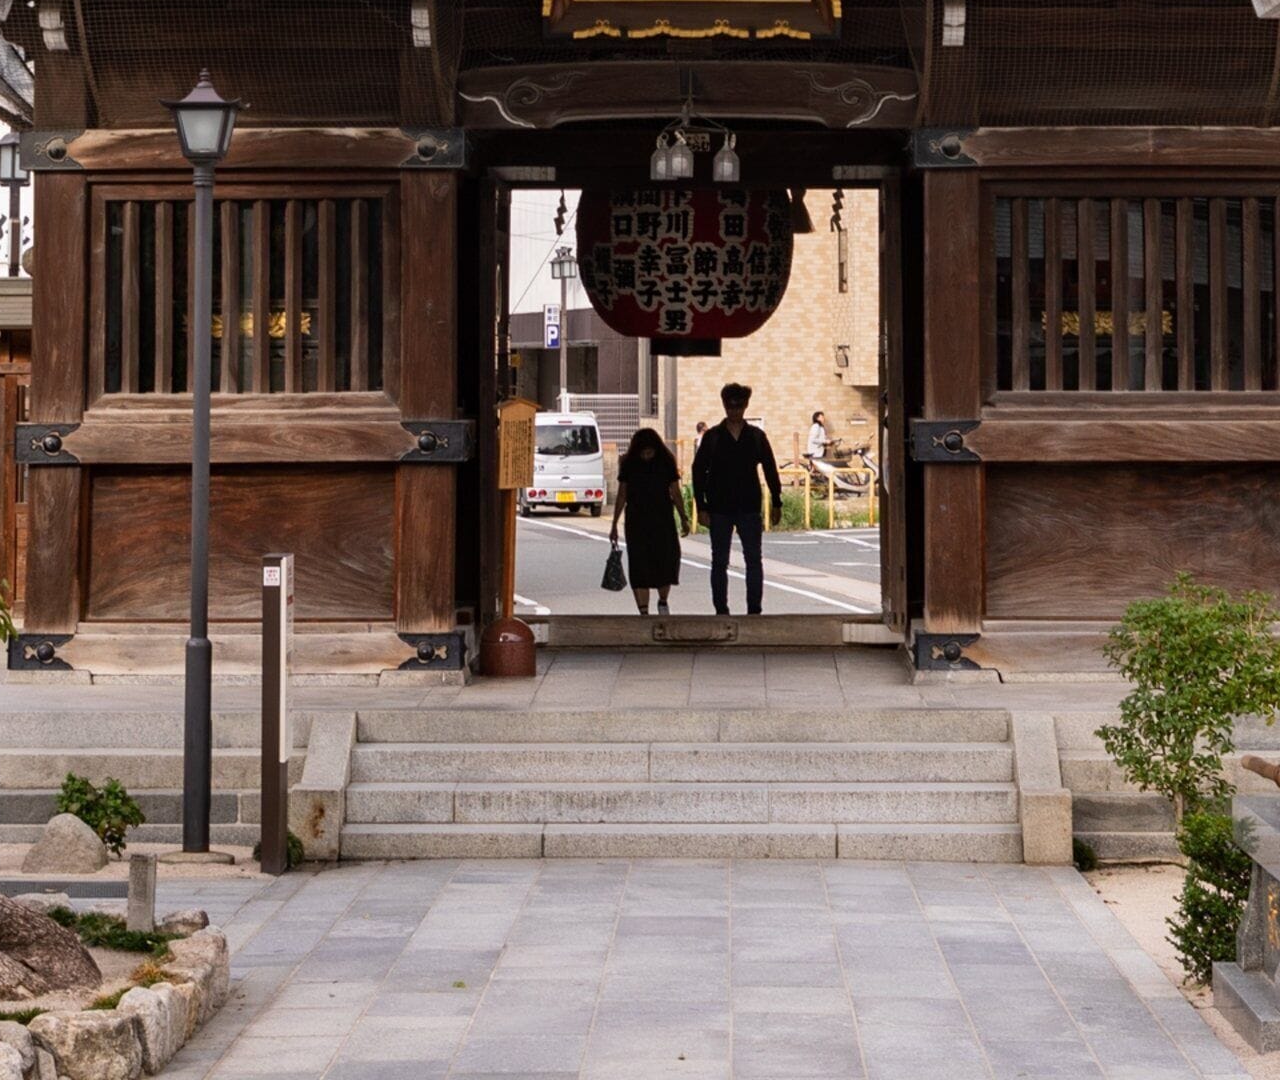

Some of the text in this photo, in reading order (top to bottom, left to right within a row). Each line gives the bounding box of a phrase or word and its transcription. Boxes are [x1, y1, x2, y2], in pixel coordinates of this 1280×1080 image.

[691, 247, 718, 307] 節子
[746, 245, 767, 309] 信子
[547, 326, 559, 346] P
